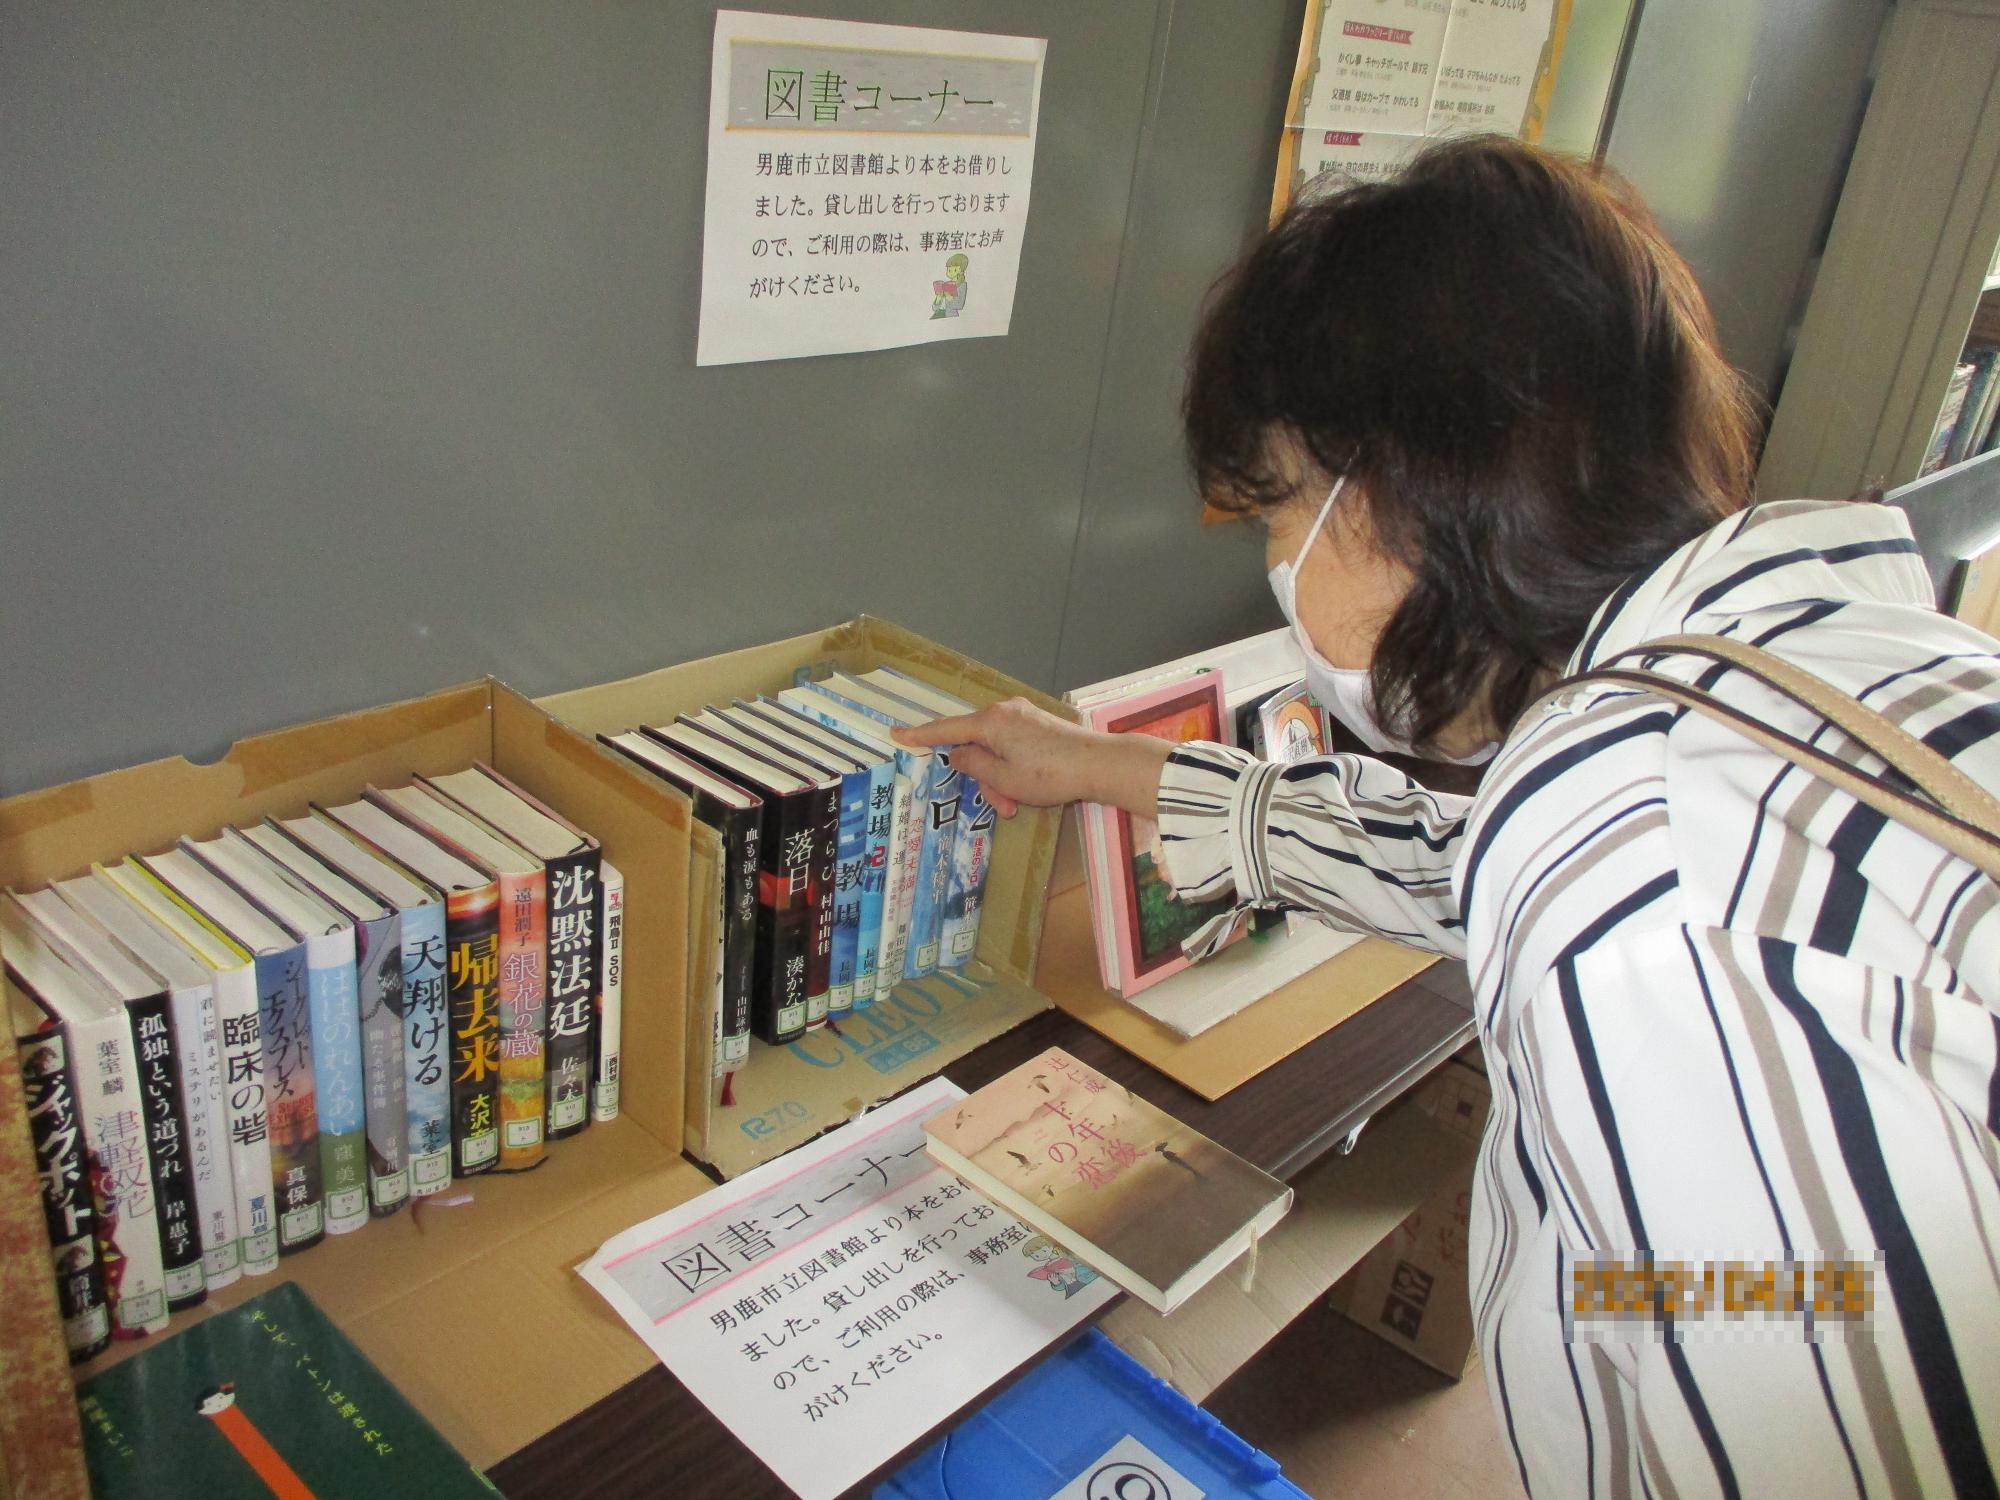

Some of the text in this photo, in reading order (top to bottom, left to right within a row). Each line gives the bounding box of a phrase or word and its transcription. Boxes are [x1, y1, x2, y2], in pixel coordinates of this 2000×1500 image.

[765, 68, 994, 124] 図書コーナー
[756, 152, 1012, 177] 男鹿市立図書館より本をお借りし
[755, 193, 1010, 217] ました。貸し出しを行っております
[752, 229, 1004, 257] ので、ご利用の際は、事務室にお声
[749, 274, 862, 299] がけください。
[785, 827, 815, 895] 落日
[821, 790, 839, 882] まつらひ
[741, 827, 759, 921] 血も涙もある
[835, 858, 864, 929] 教場
[551, 865, 596, 1041] 沈黙法廷
[818, 894, 832, 957] 村山由佳
[503, 952, 544, 1058] 銀花の蔵
[609, 955, 619, 987] SOS
[403, 935, 448, 1085] 天翔ける
[451, 933, 499, 1084] 帰去来
[97, 1039, 125, 1097] 葉室麟
[138, 1013, 184, 1180] 孤独という道づれ
[222, 1012, 267, 1146] 臨床の砦
[287, 1166, 308, 1209] 真保
[333, 1144, 355, 1191] 窪美
[740, 1199, 1001, 1363] ました。貸し出しを行ってお
[803, 1331, 944, 1423] がけください。
